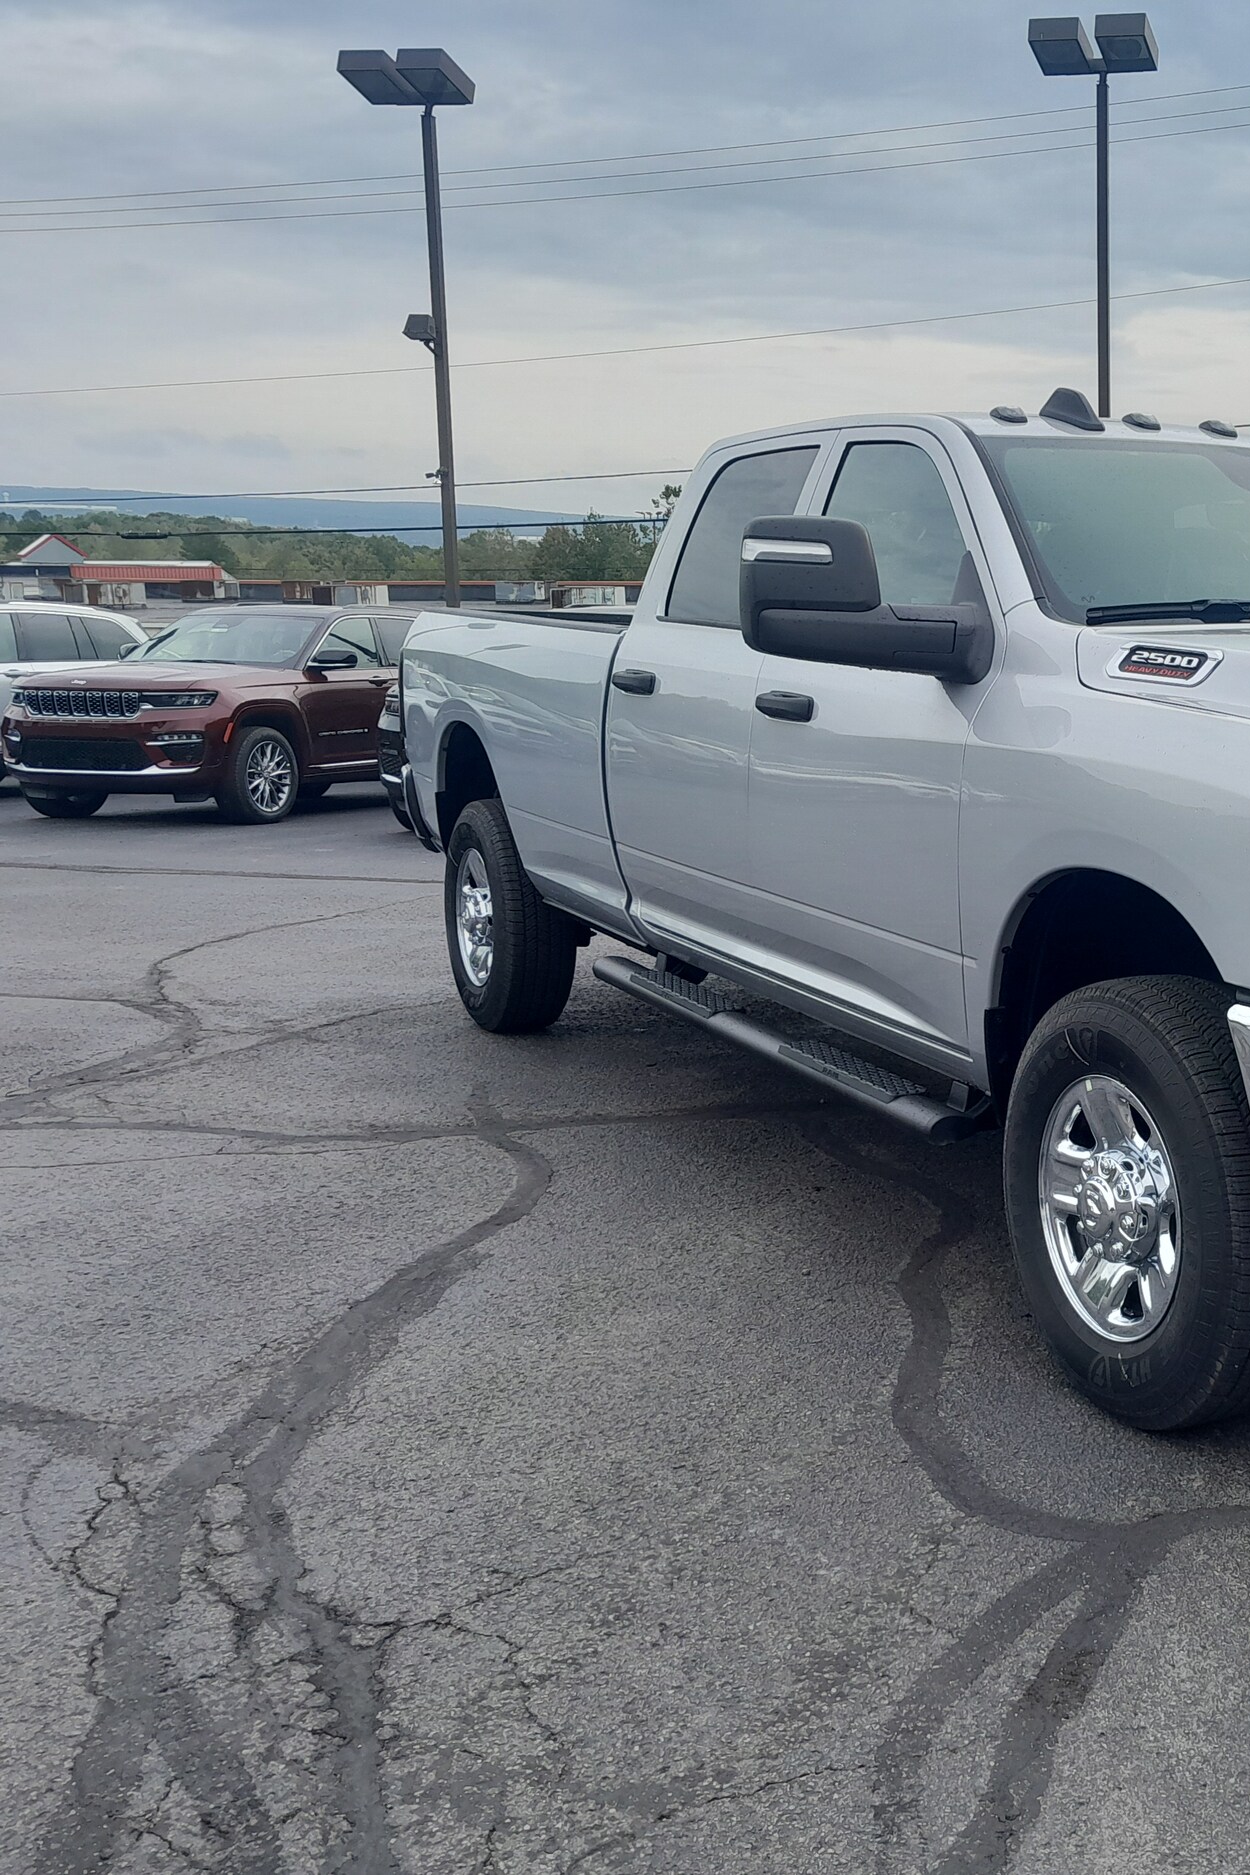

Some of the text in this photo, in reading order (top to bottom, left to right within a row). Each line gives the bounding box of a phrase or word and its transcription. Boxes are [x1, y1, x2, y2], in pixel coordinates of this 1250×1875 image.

[1131, 650, 1199, 668] 2500
[1125, 665, 1191, 678] HEAVY DUTY
